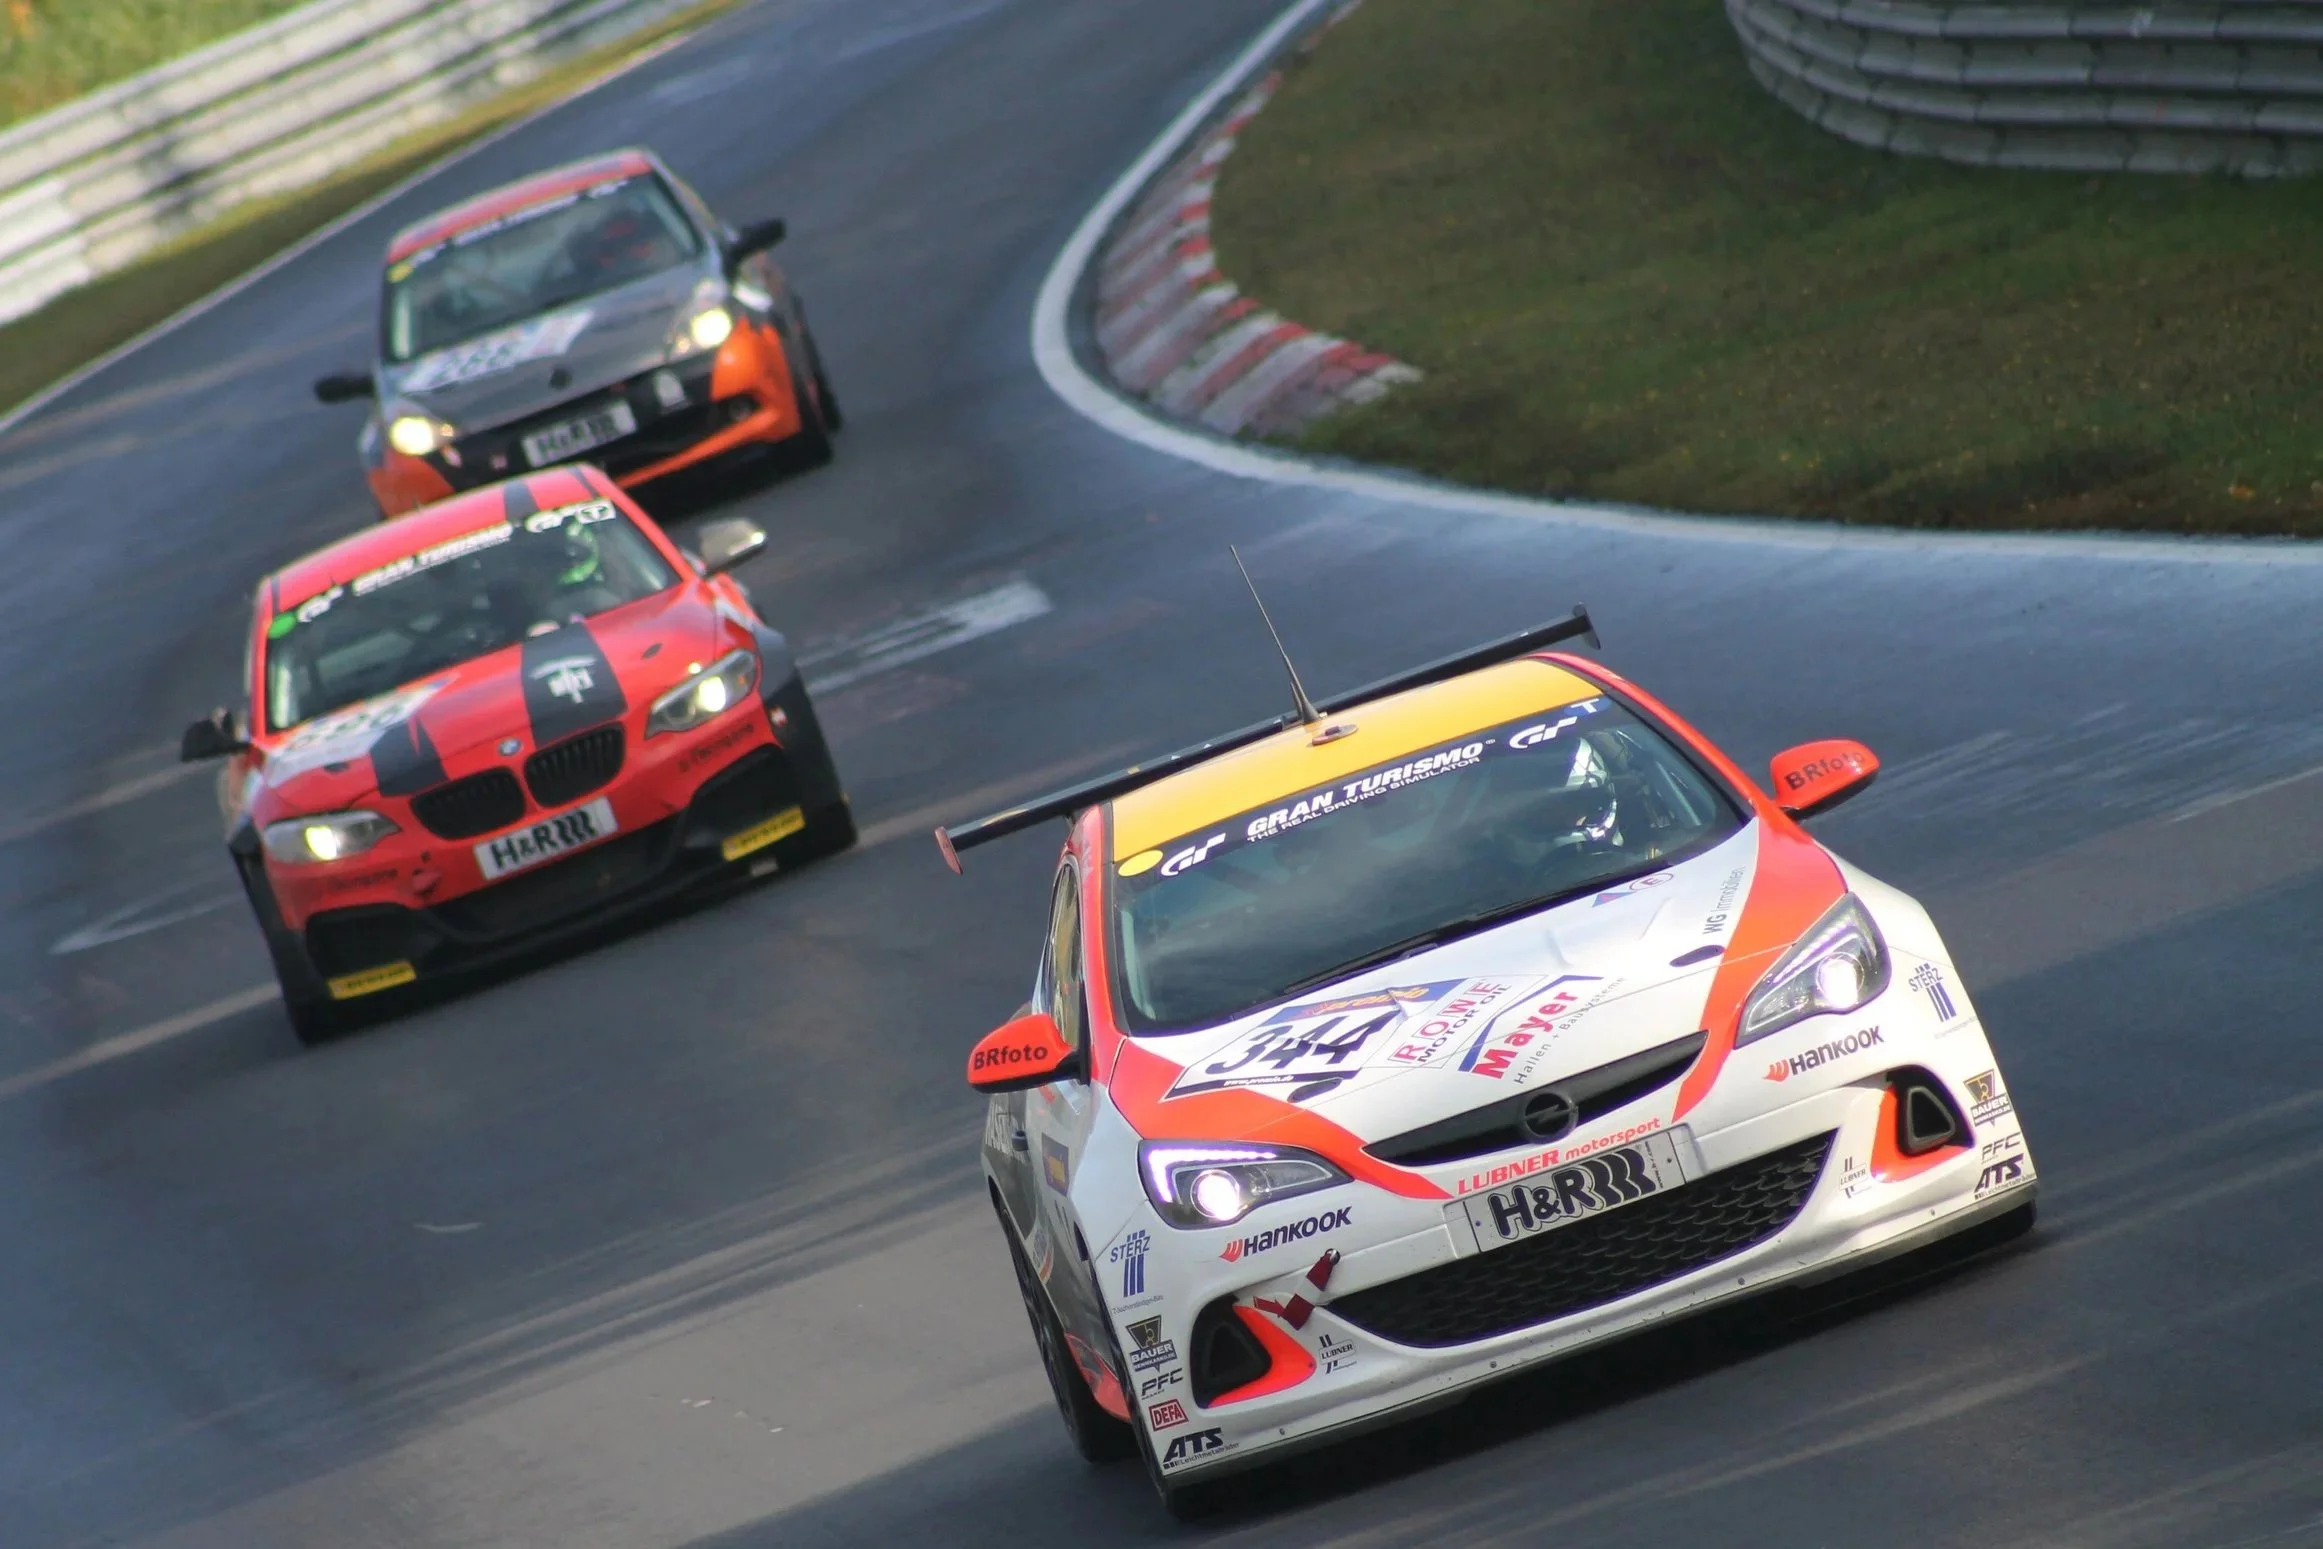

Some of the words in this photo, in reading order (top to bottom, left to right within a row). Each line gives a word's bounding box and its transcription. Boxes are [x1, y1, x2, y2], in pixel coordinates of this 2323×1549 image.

[1247, 791, 1334, 836] GRAN
[1343, 742, 1484, 798] TURISMO
[1784, 750, 1867, 791] BRfoto
[1247, 829, 1279, 843] THE
[1281, 810, 1322, 831] REAL
[1323, 785, 1387, 814] DRIVING
[1389, 756, 1481, 789] SIMULATOR
[1702, 914, 1728, 935] WG
[1908, 967, 1943, 992] STERZ
[1394, 981, 1500, 1062] ROWE
[1417, 1009, 1479, 1062] MOTOR
[1481, 984, 1512, 1006] OIL
[1472, 992, 1579, 1079] Mayer
[1513, 1043, 1551, 1084] Hallen
[1559, 977, 1627, 1031] Bausysteme
[974, 1044, 1048, 1070] BRfoto
[1205, 1009, 1400, 1074] 344
[1972, 1096, 2009, 1118] BAUER
[1458, 1150, 1560, 1195] LUBNER
[1565, 1118, 1660, 1160] motorsport
[1982, 1132, 2021, 1161] PFC
[1974, 1153, 2024, 1193] ATS
[1488, 1165, 1606, 1239] H&R
[1110, 1235, 1151, 1263] STERZ
[1131, 1343, 1174, 1363] BAUER
[1321, 1344, 1354, 1359] LUBNER
[1141, 1368, 1184, 1396] PFC
[1153, 1404, 1182, 1425] DEFA
[1163, 1427, 1223, 1463] ATS
